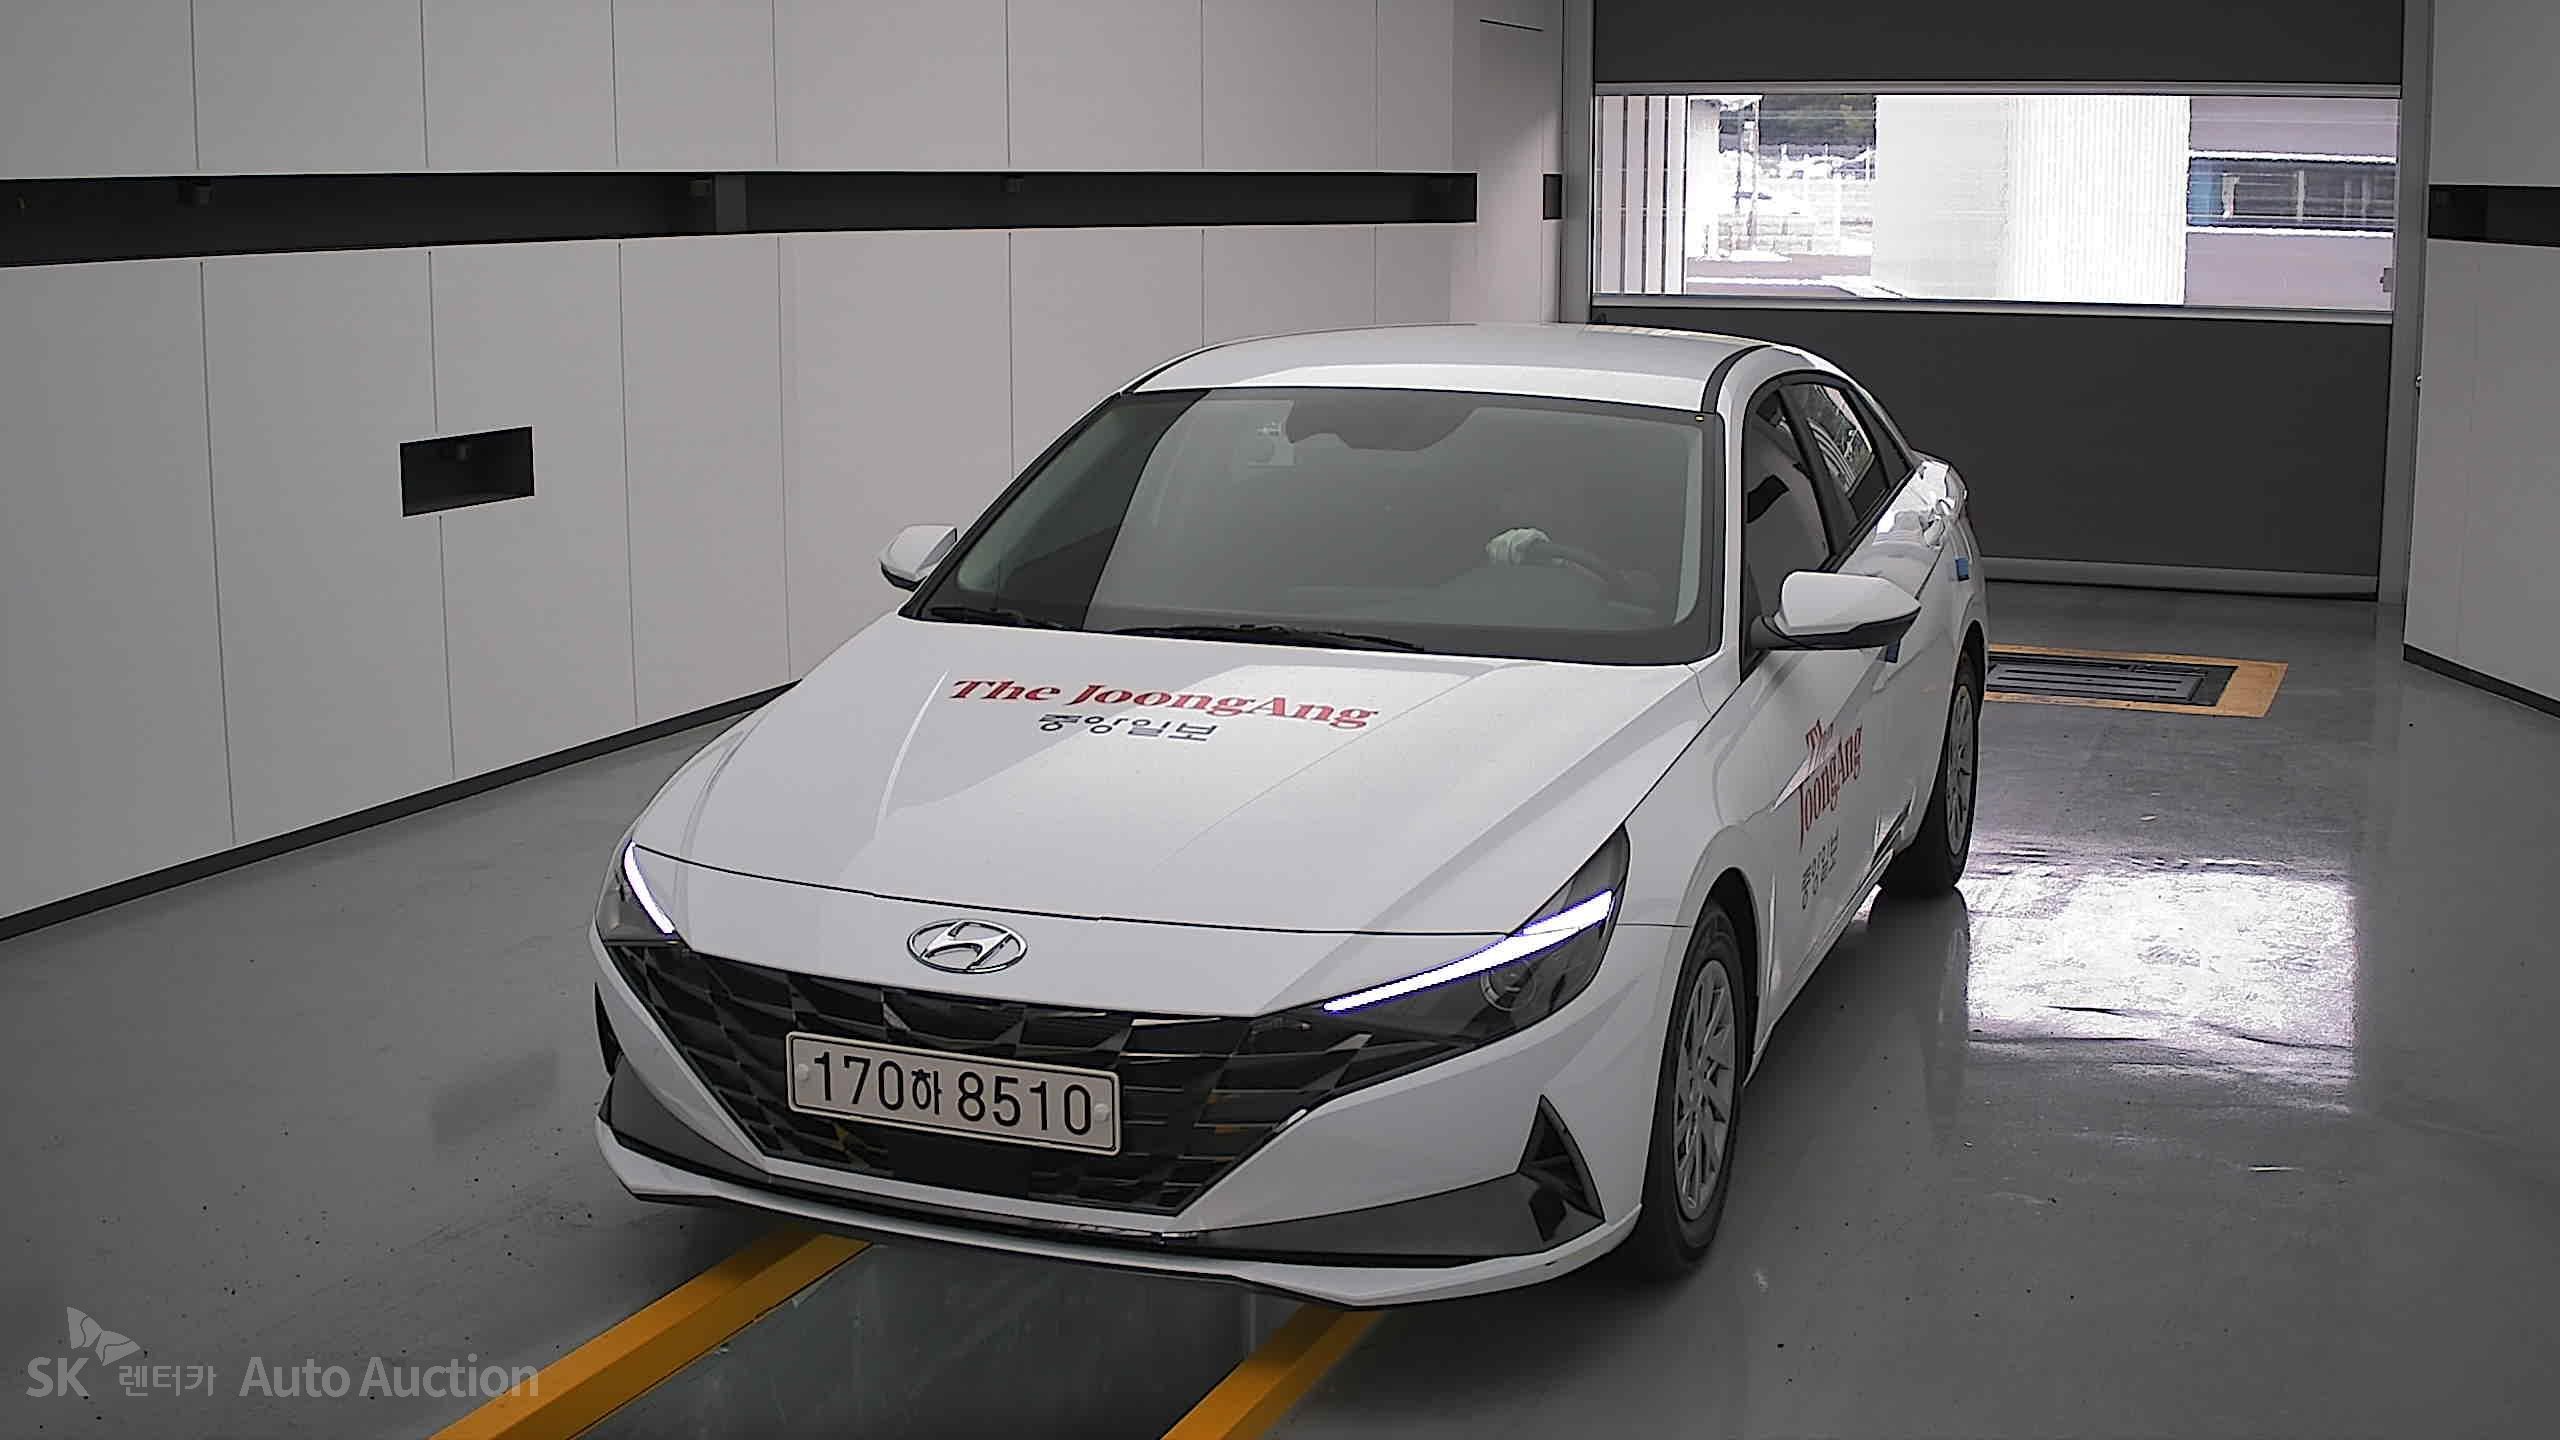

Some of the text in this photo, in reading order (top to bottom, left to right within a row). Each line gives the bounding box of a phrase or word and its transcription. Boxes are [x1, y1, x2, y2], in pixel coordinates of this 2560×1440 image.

[950, 679, 1378, 730] The JoongAng
[1039, 713, 1218, 742] 중앙일보
[1799, 726, 1863, 851] JoongAng
[814, 1051, 1092, 1136] 170하 8510
